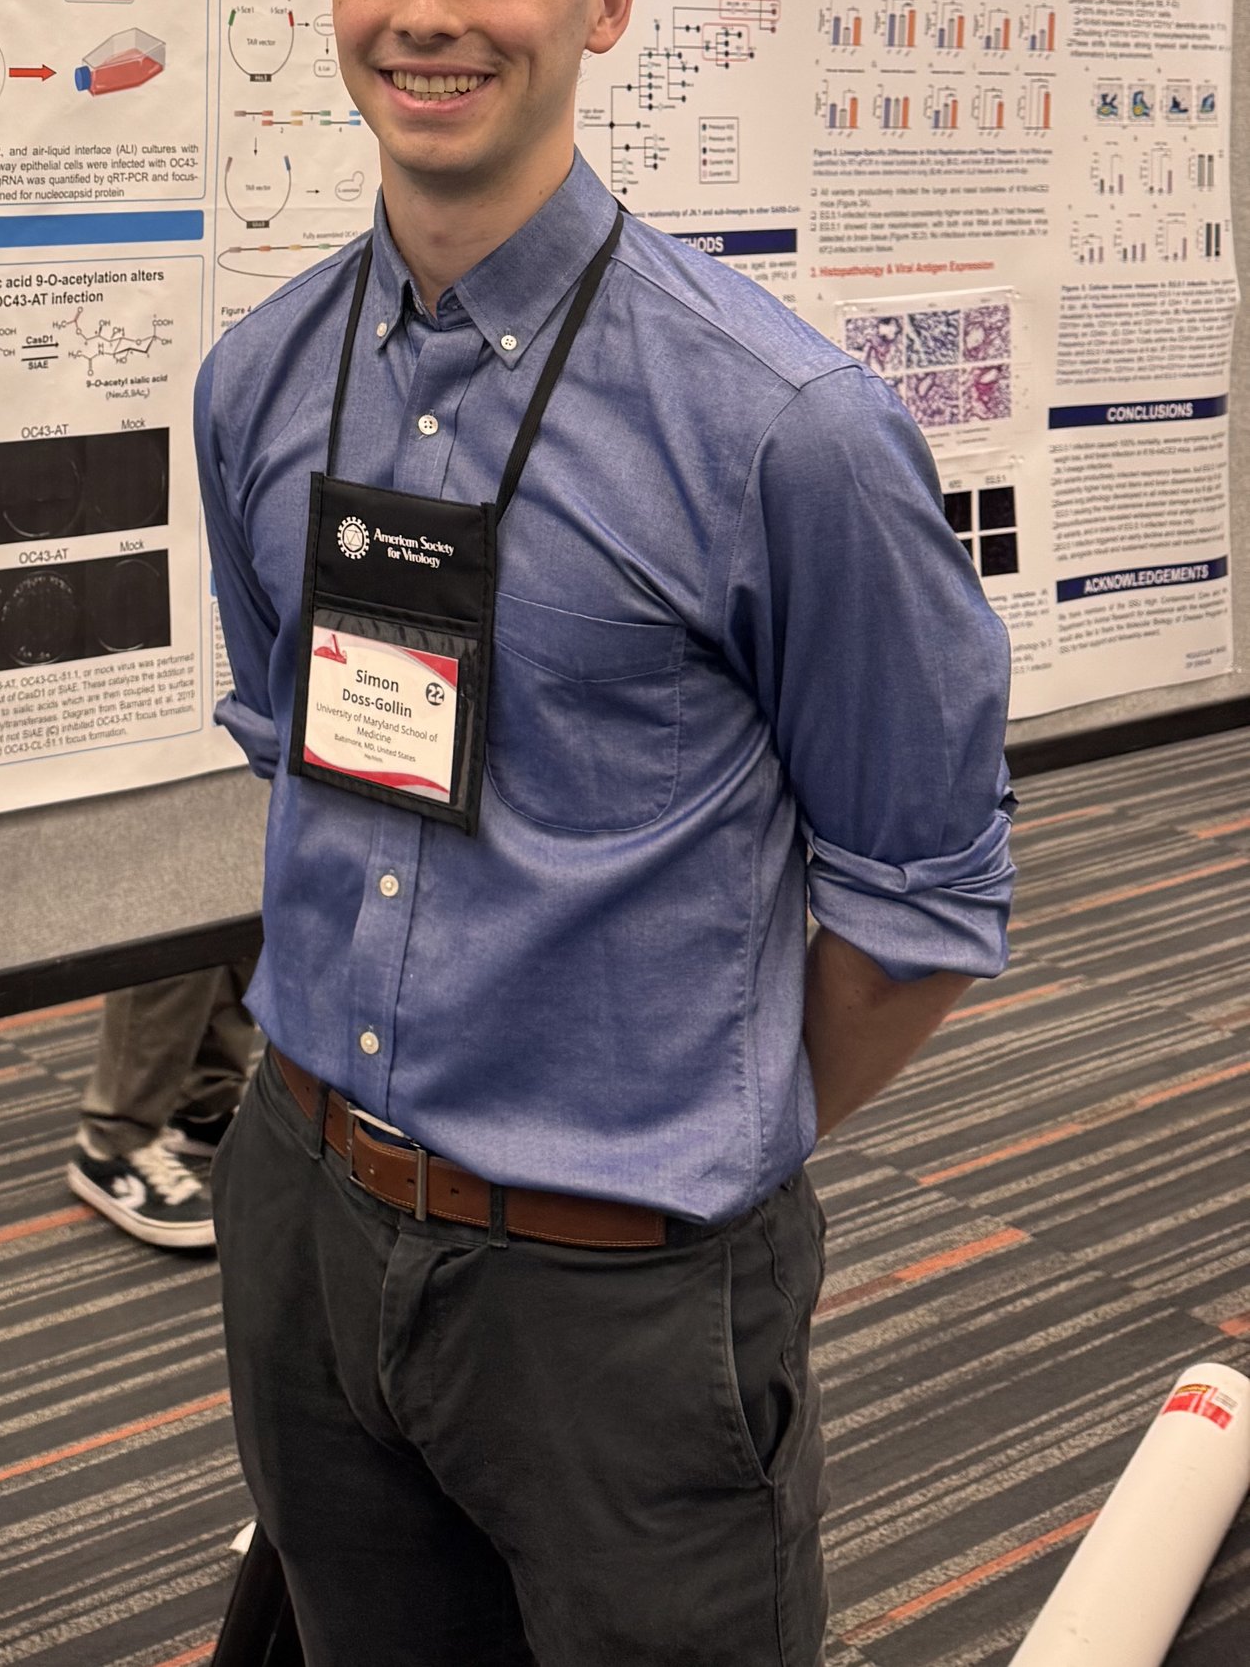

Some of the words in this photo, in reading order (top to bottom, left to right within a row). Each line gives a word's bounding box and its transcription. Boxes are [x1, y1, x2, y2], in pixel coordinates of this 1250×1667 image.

[5, 274, 32, 288] acid
[35, 270, 127, 287] 9-O-acetylation
[130, 269, 164, 282] alters
[51, 290, 103, 305] infection
[1106, 402, 1194, 423] CONCLUSIONS
[373, 528, 418, 548] American
[419, 535, 454, 556] Society
[387, 546, 401, 559] for
[400, 547, 440, 568] Virology
[1083, 564, 1209, 595] ACKNOWLEDGEMENTS
[355, 669, 400, 693] Simon
[342, 688, 412, 718] Doss-Gollin
[427, 684, 445, 704] 22
[316, 701, 352, 722] University
[353, 712, 362, 722] of
[400, 724, 427, 740] School
[428, 733, 438, 742] of
[356, 726, 392, 744] Medicine
